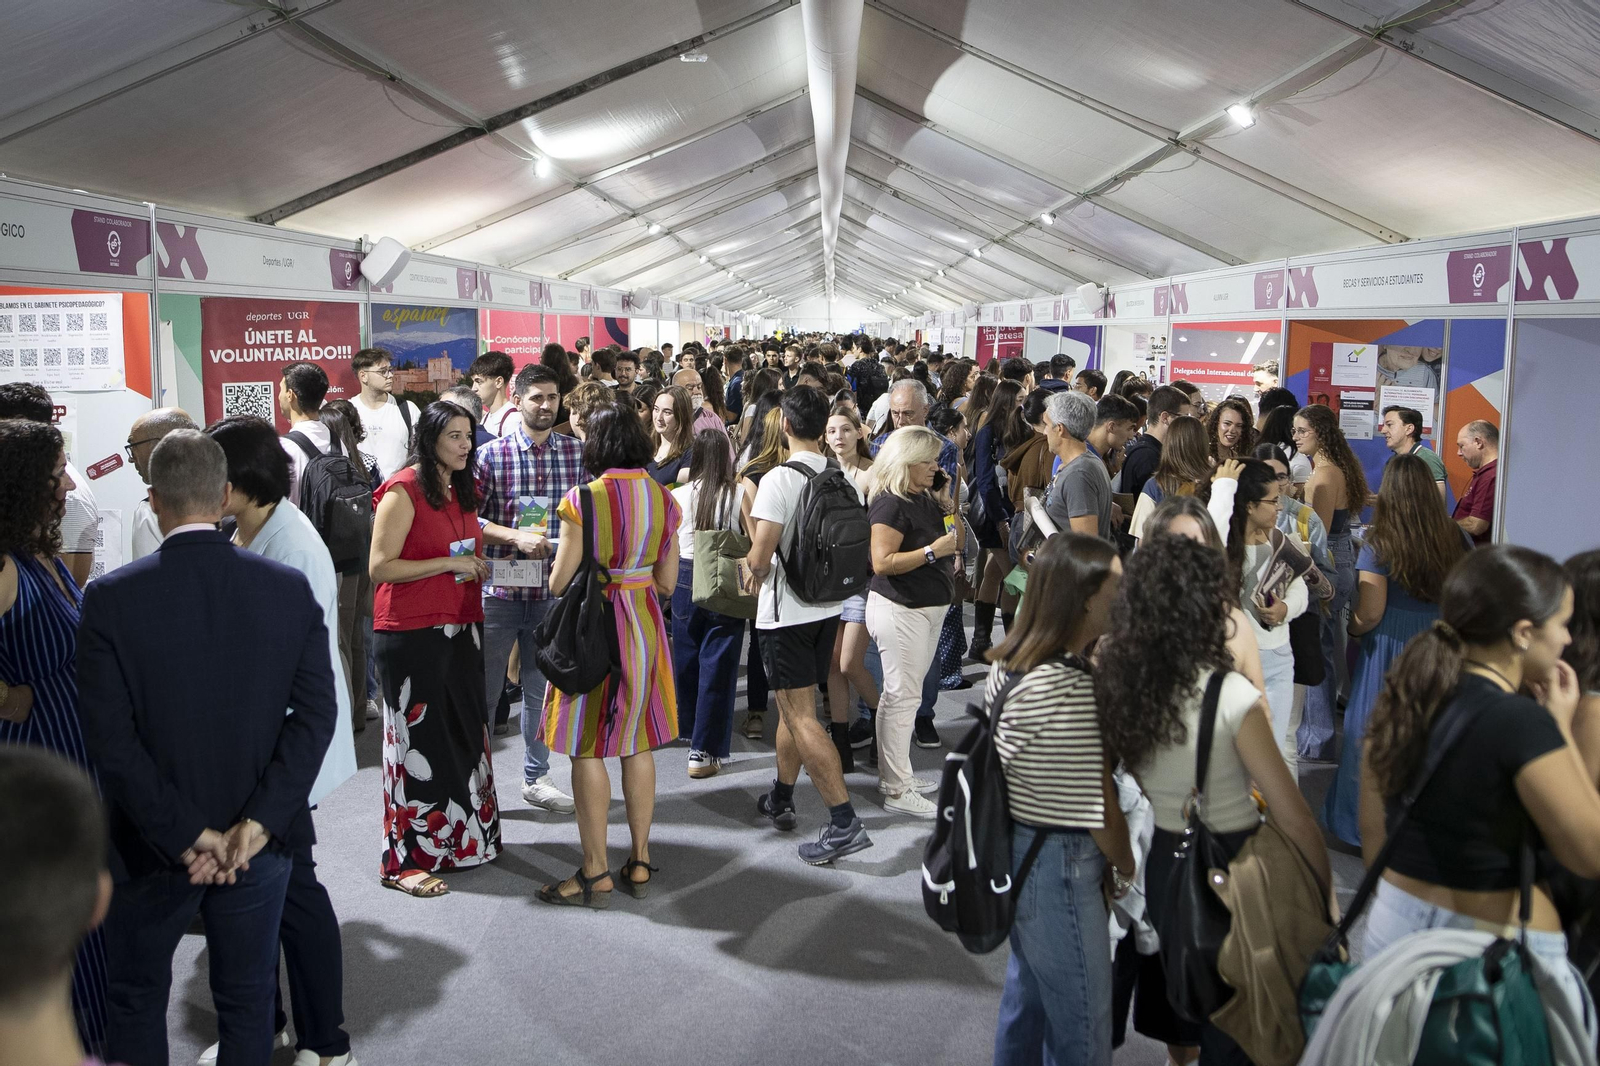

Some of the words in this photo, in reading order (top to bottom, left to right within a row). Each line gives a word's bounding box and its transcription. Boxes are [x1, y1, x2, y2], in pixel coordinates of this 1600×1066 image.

[1, 222, 25, 239] GICO
[262, 255, 281, 267] Deportes
[1343, 278, 1357, 288] BECAS
[1357, 278, 1360, 287] Y
[1361, 276, 1385, 287] SERVICIOS
[1385, 276, 1389, 285] A
[1389, 273, 1424, 285] ESTUDIANTES
[34, 301, 58, 309] GABINETE
[246, 312, 282, 323] deportes
[287, 311, 310, 320] UGR
[244, 327, 293, 345] ÚNETE
[297, 329, 317, 343] AL
[544, 335, 550, 344] y
[209, 345, 352, 364] VOLUNTARIADO!!!
[1173, 367, 1206, 376] Delegación
[1206, 368, 1246, 377] Internacional
